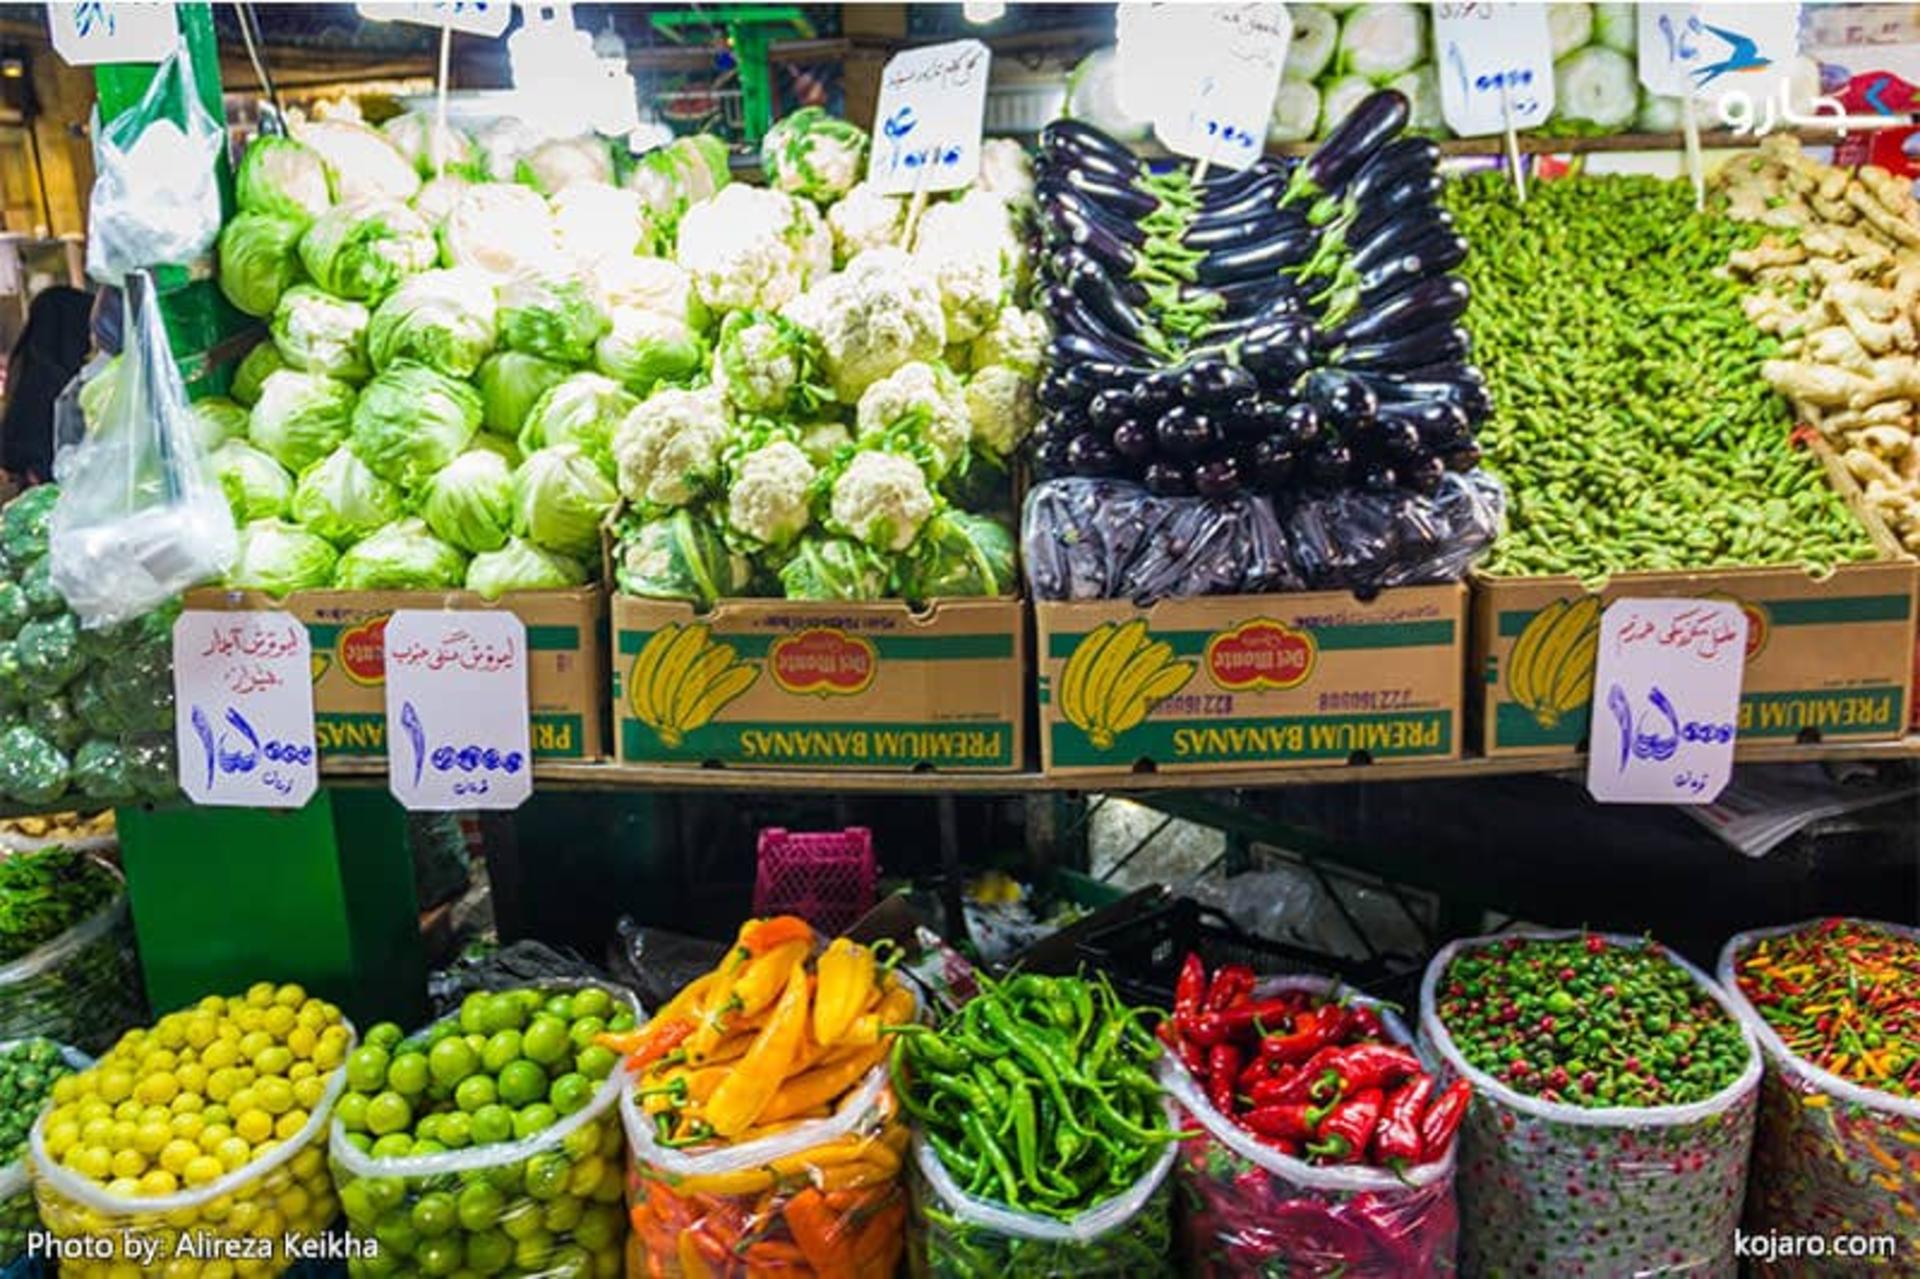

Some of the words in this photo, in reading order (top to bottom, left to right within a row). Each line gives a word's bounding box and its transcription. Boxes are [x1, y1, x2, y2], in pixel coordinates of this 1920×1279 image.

[1760, 696, 1891, 729] PREMIUM
[318, 722, 385, 747] ANAS
[401, 701, 523, 788] ۱۰۰۰۰
[741, 730, 868, 758] BANANAS
[873, 730, 1000, 758] PREMIUM
[1173, 725, 1303, 756] BANANAS
[1309, 719, 1441, 751] PREMIUM
[1608, 683, 1734, 776] ۱۵۰۰۰
[191, 705, 313, 791] ۱۵۰۰۰
